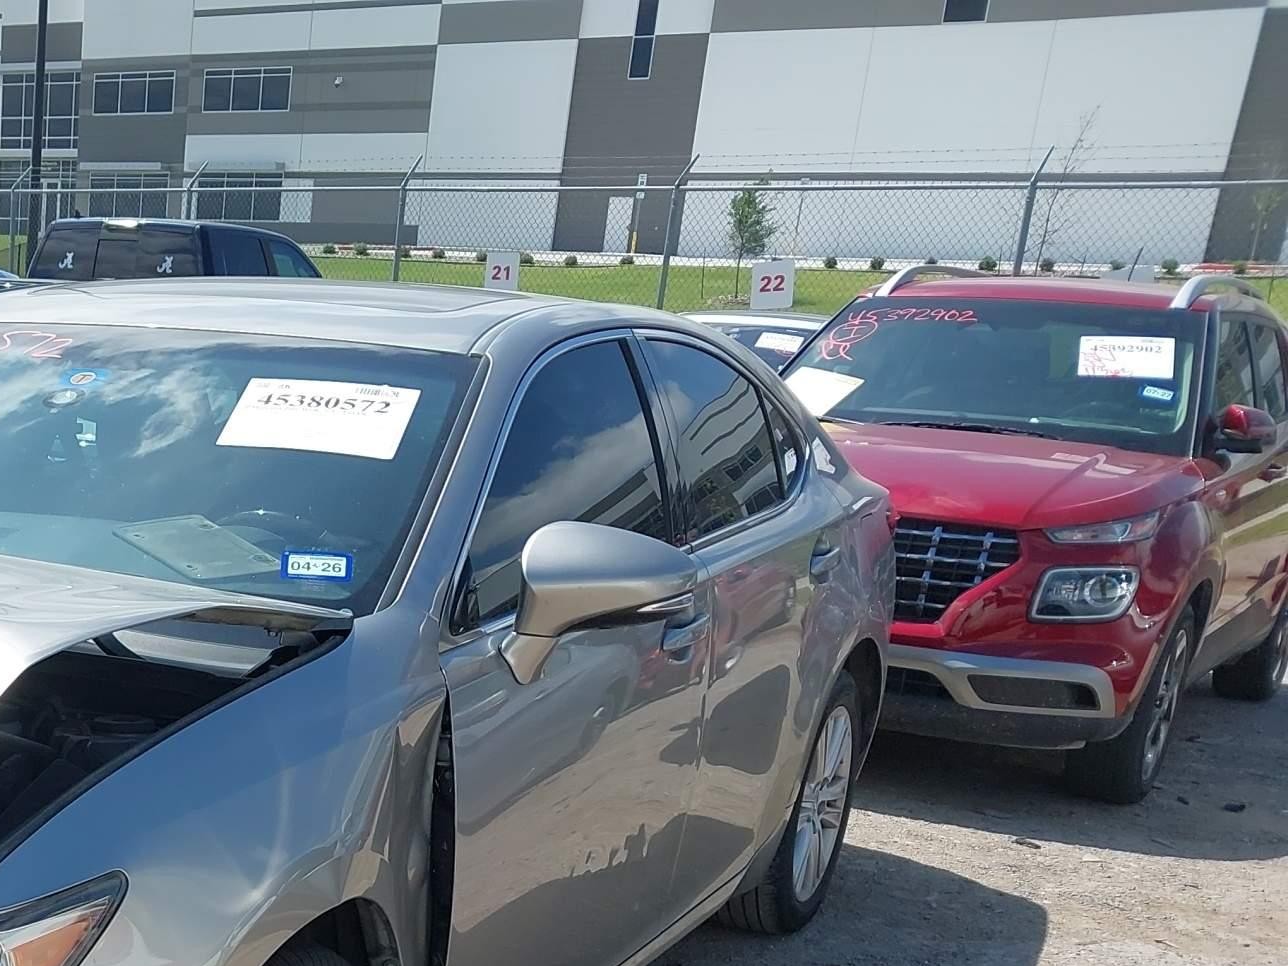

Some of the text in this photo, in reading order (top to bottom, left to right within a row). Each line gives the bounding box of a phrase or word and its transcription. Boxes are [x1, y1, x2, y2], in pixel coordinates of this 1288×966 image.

[491, 265, 511, 281] 21
[759, 274, 785, 293] 22
[848, 307, 977, 324] 45392902
[257, 393, 391, 414] 45380572
